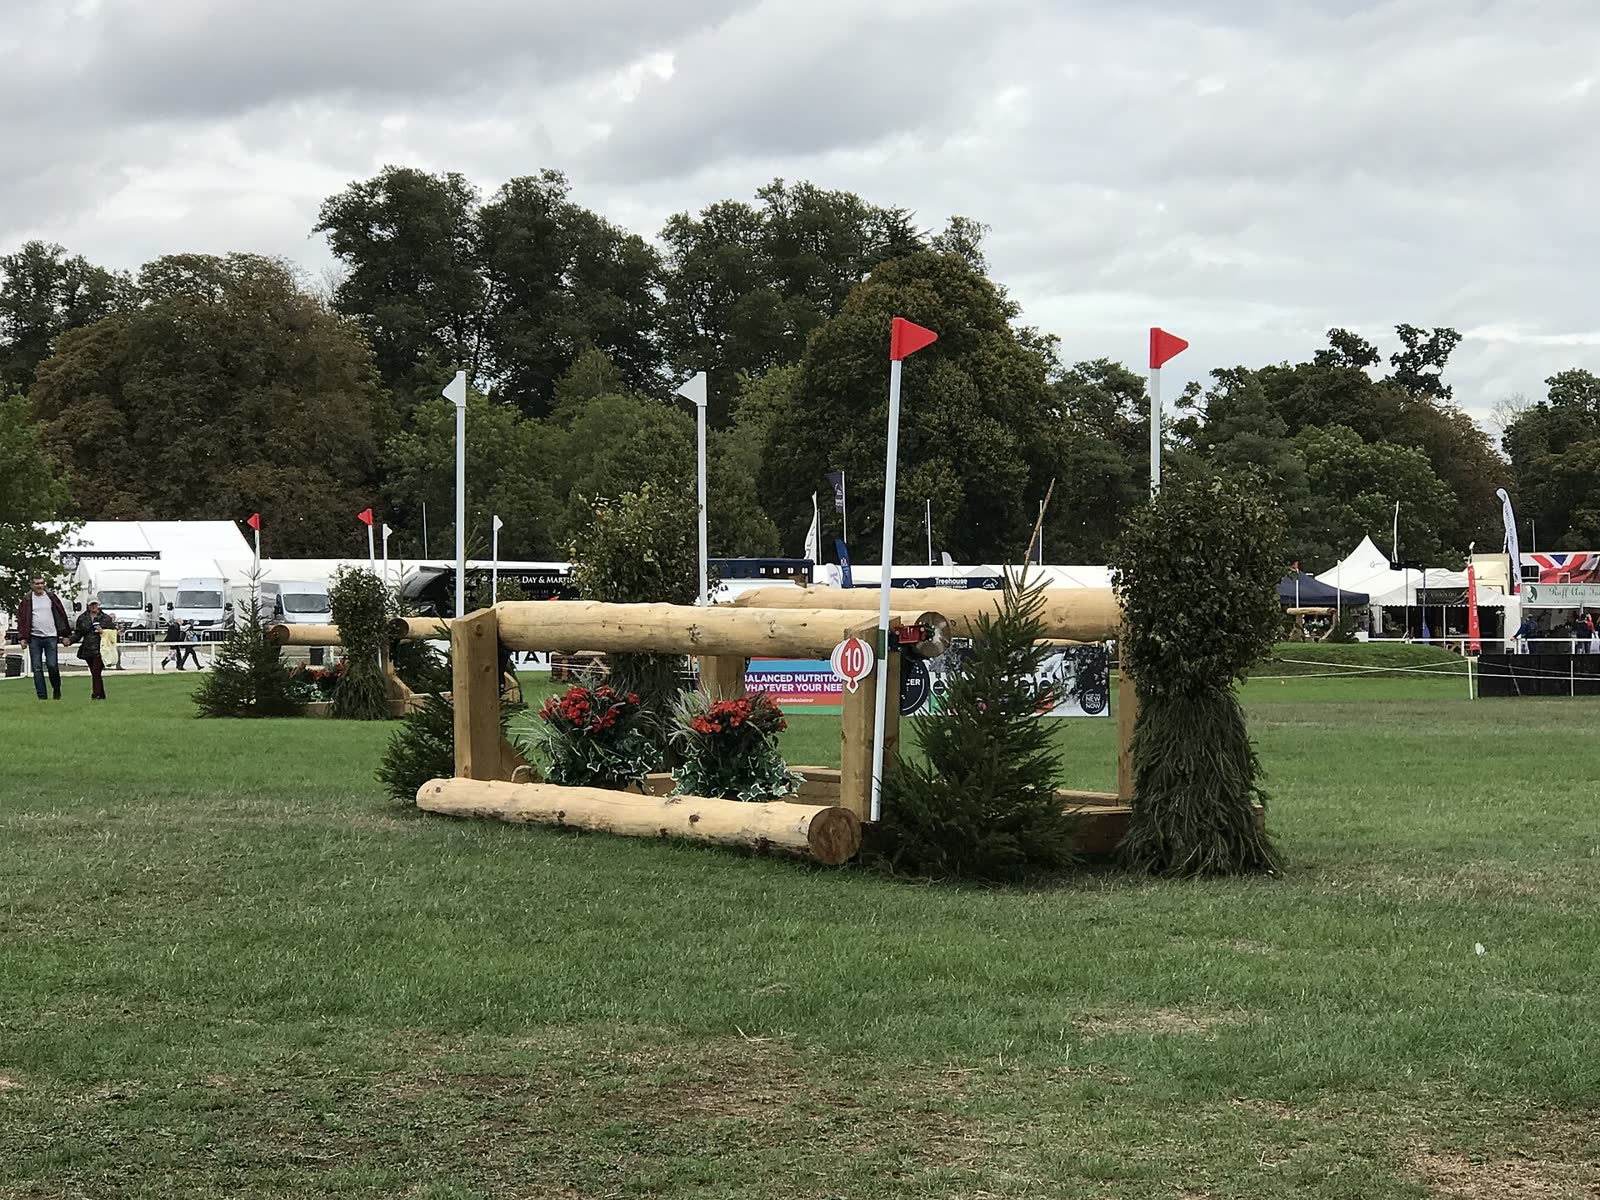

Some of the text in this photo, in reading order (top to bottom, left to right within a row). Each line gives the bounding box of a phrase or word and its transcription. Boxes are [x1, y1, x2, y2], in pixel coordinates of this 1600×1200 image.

[522, 576, 537, 584] DAY
[538, 576, 546, 584] &
[547, 576, 575, 584] MARTIN
[935, 577, 968, 585] Treehouse
[515, 651, 550, 664] IAT
[845, 648, 861, 672] 10
[796, 684, 822, 692] YOUR
[823, 684, 843, 692] NEE
